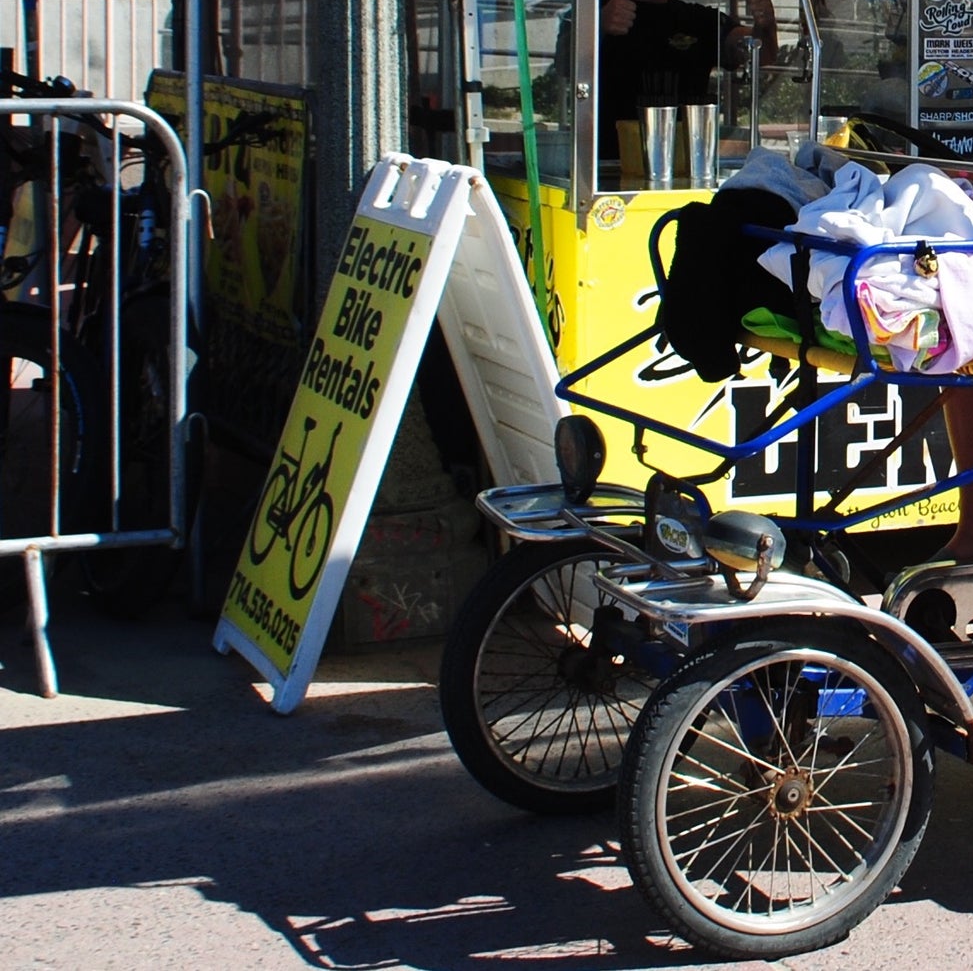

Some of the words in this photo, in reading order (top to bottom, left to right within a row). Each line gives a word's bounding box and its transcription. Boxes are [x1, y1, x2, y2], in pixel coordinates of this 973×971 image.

[926, 39, 951, 48] MARK
[337, 225, 423, 299] Electric
[332, 286, 382, 351] Bike
[302, 337, 380, 419] Rentals
[226, 571, 300, 656] 714.536.0215
